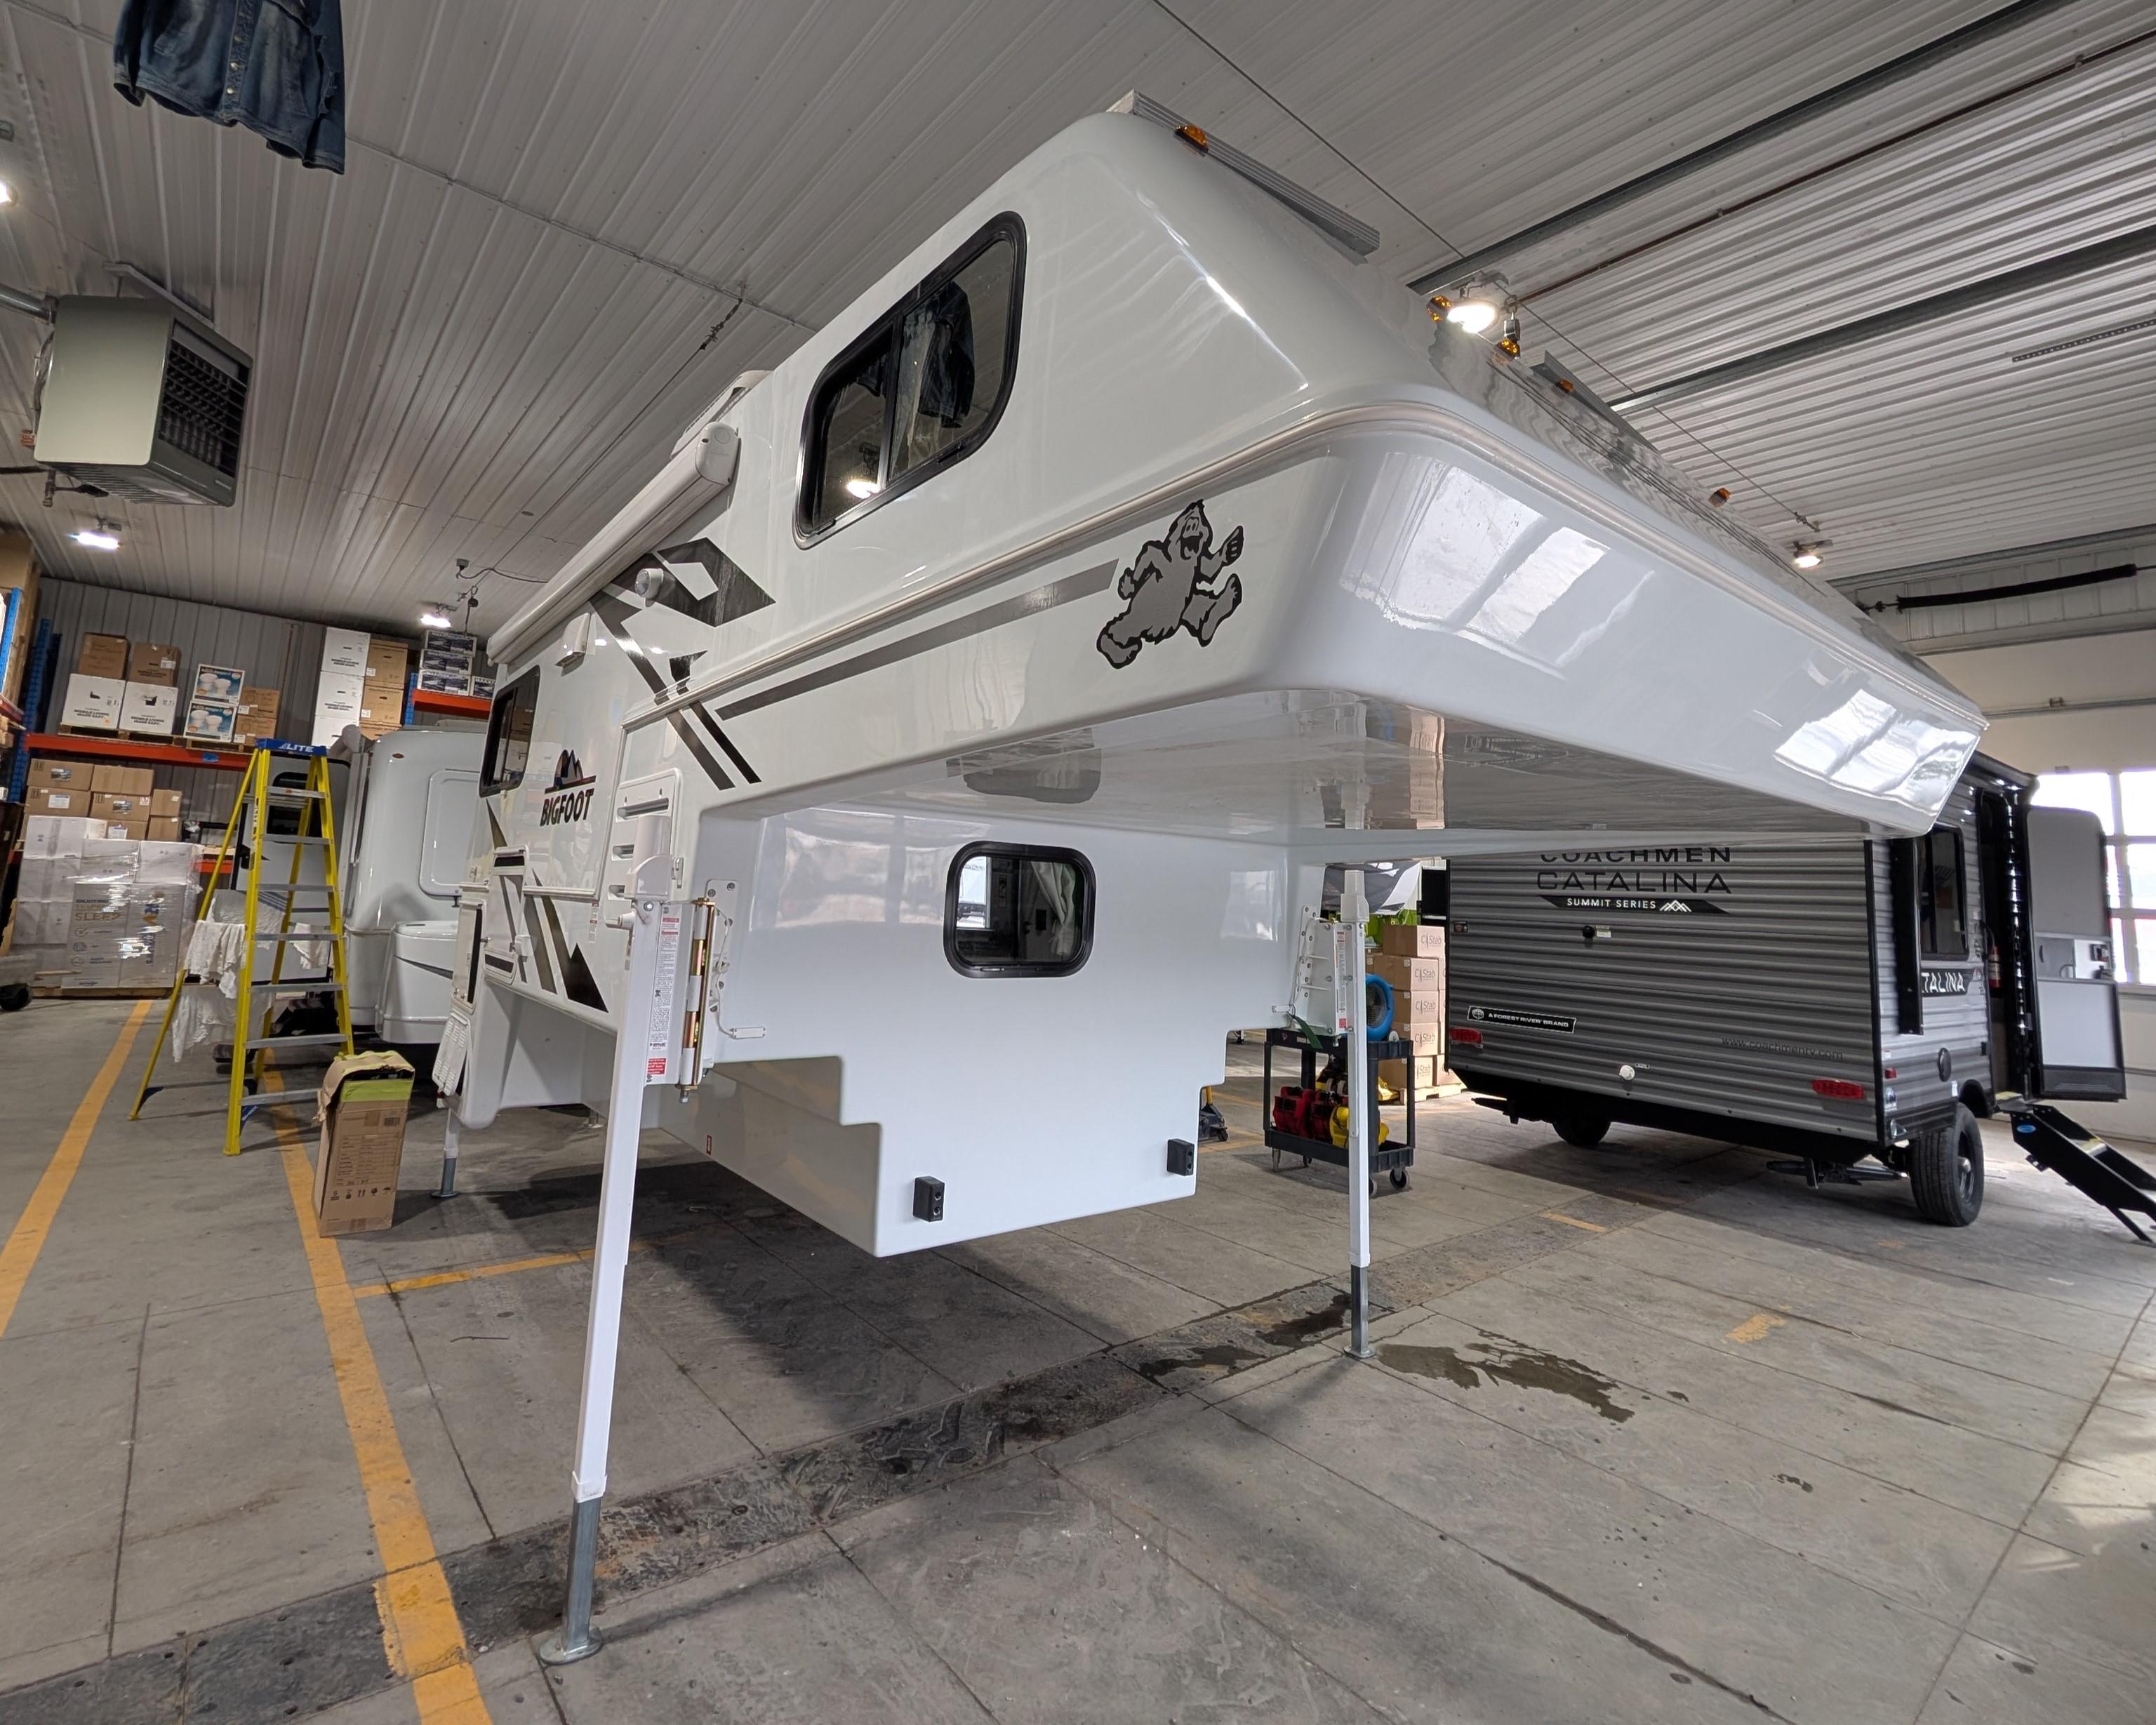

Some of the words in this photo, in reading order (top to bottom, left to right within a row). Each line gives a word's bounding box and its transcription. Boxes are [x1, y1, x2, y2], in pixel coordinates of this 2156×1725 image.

[540, 788, 594, 827] BIGFOOT
[1541, 847, 1731, 863] COACHMEN
[1537, 871, 1732, 894] CATALINA
[1567, 898, 1611, 907] SUMMIT
[1616, 899, 1656, 910] SERIES
[1922, 972, 1966, 994] TALINA
[1722, 1038, 1843, 1060] www.coachmenrv.com
